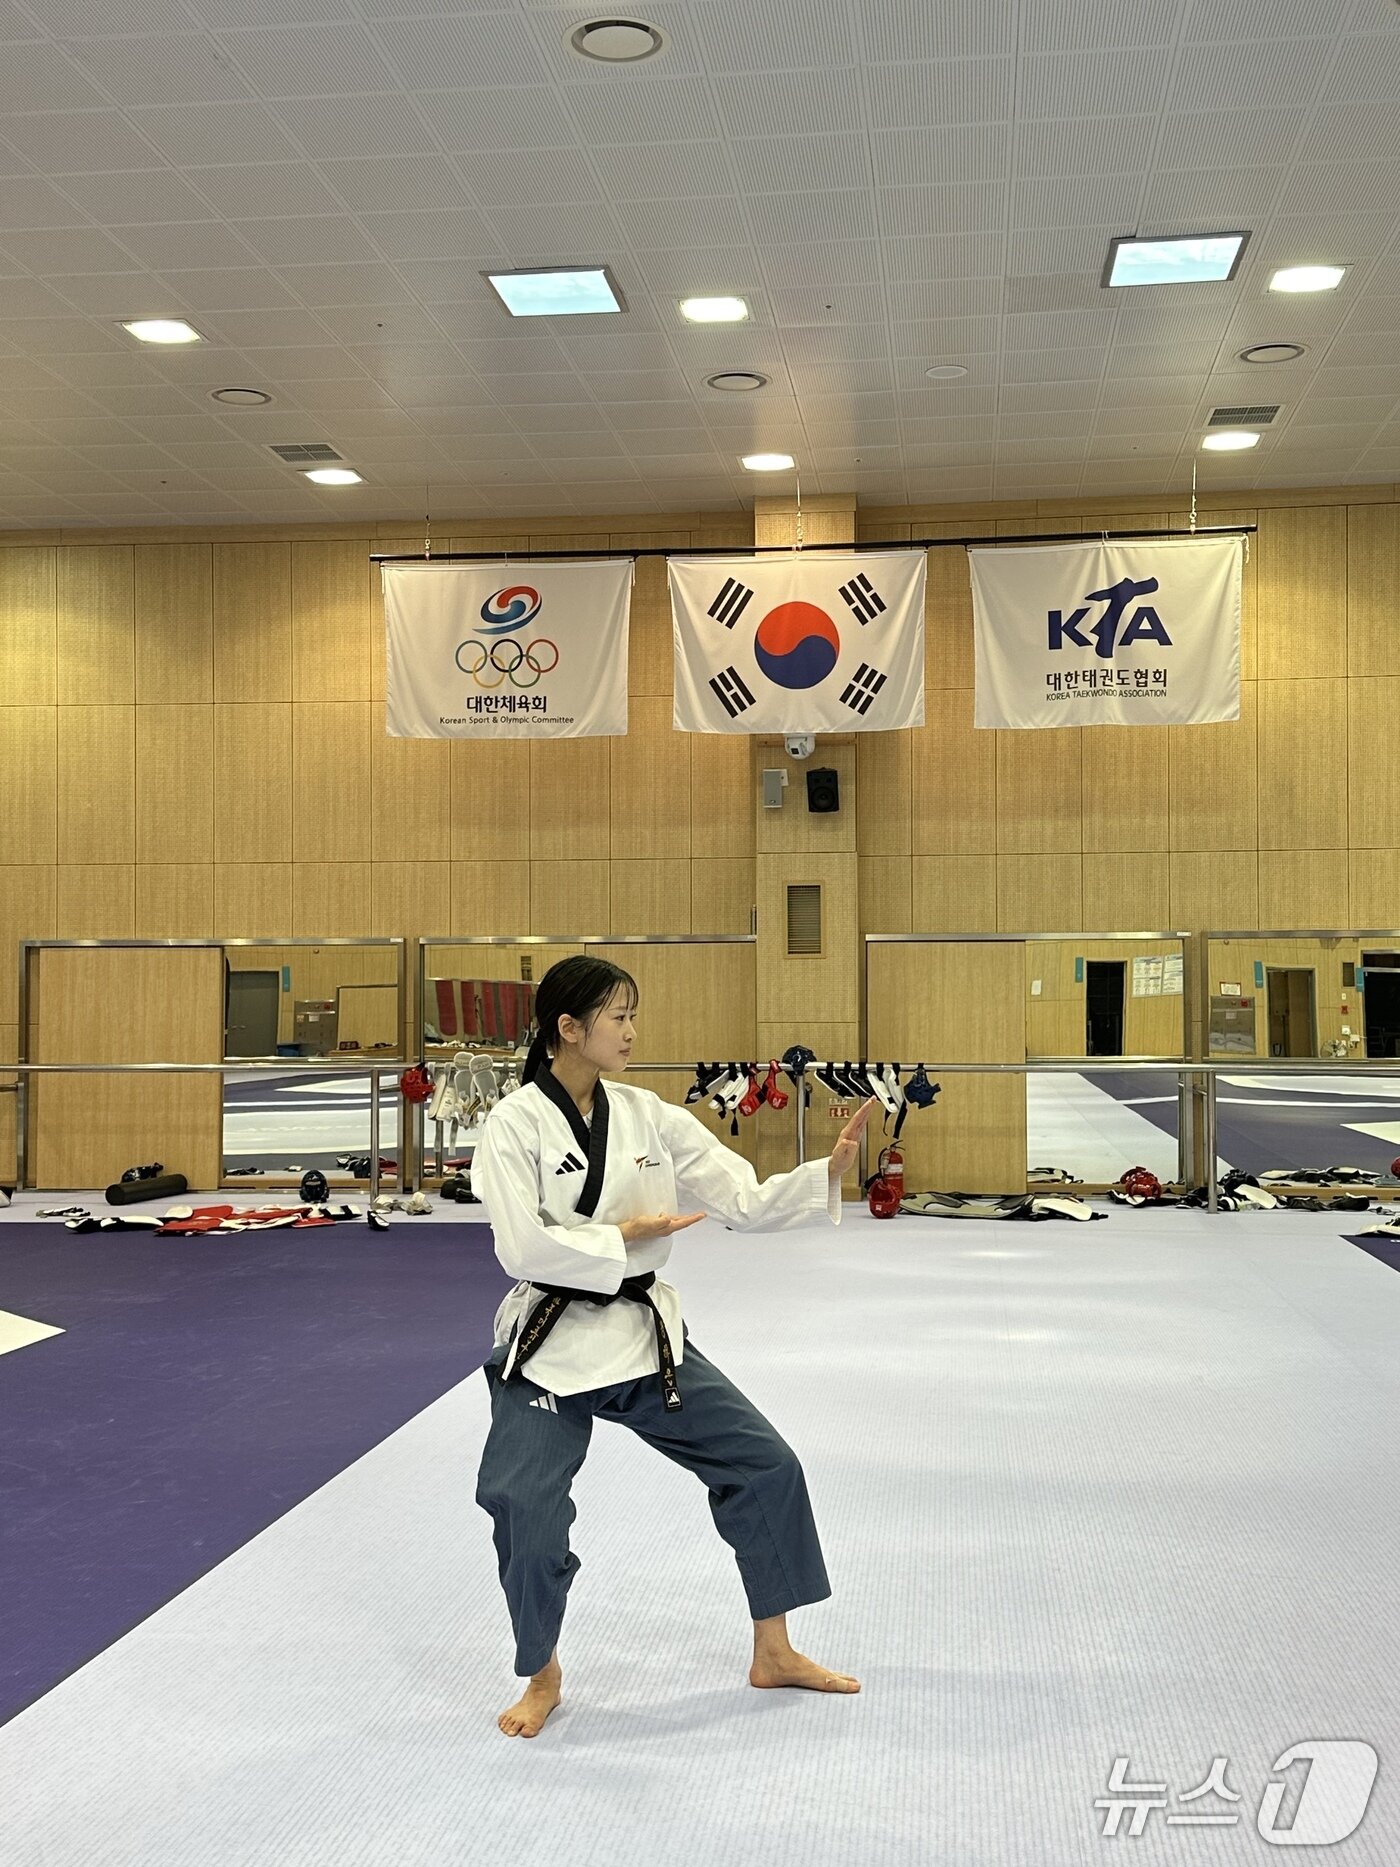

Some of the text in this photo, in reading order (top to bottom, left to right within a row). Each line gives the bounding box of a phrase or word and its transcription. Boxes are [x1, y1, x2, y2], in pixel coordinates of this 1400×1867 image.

[1048, 577, 1173, 659] KTA
[1046, 668, 1167, 691] 대한태권도협회
[1046, 688, 1167, 701] KOREA TAEKWONDO ASSOCIATION
[466, 695, 547, 713] 대한체육회
[439, 715, 574, 725] Korean Sport & Olympic Committee
